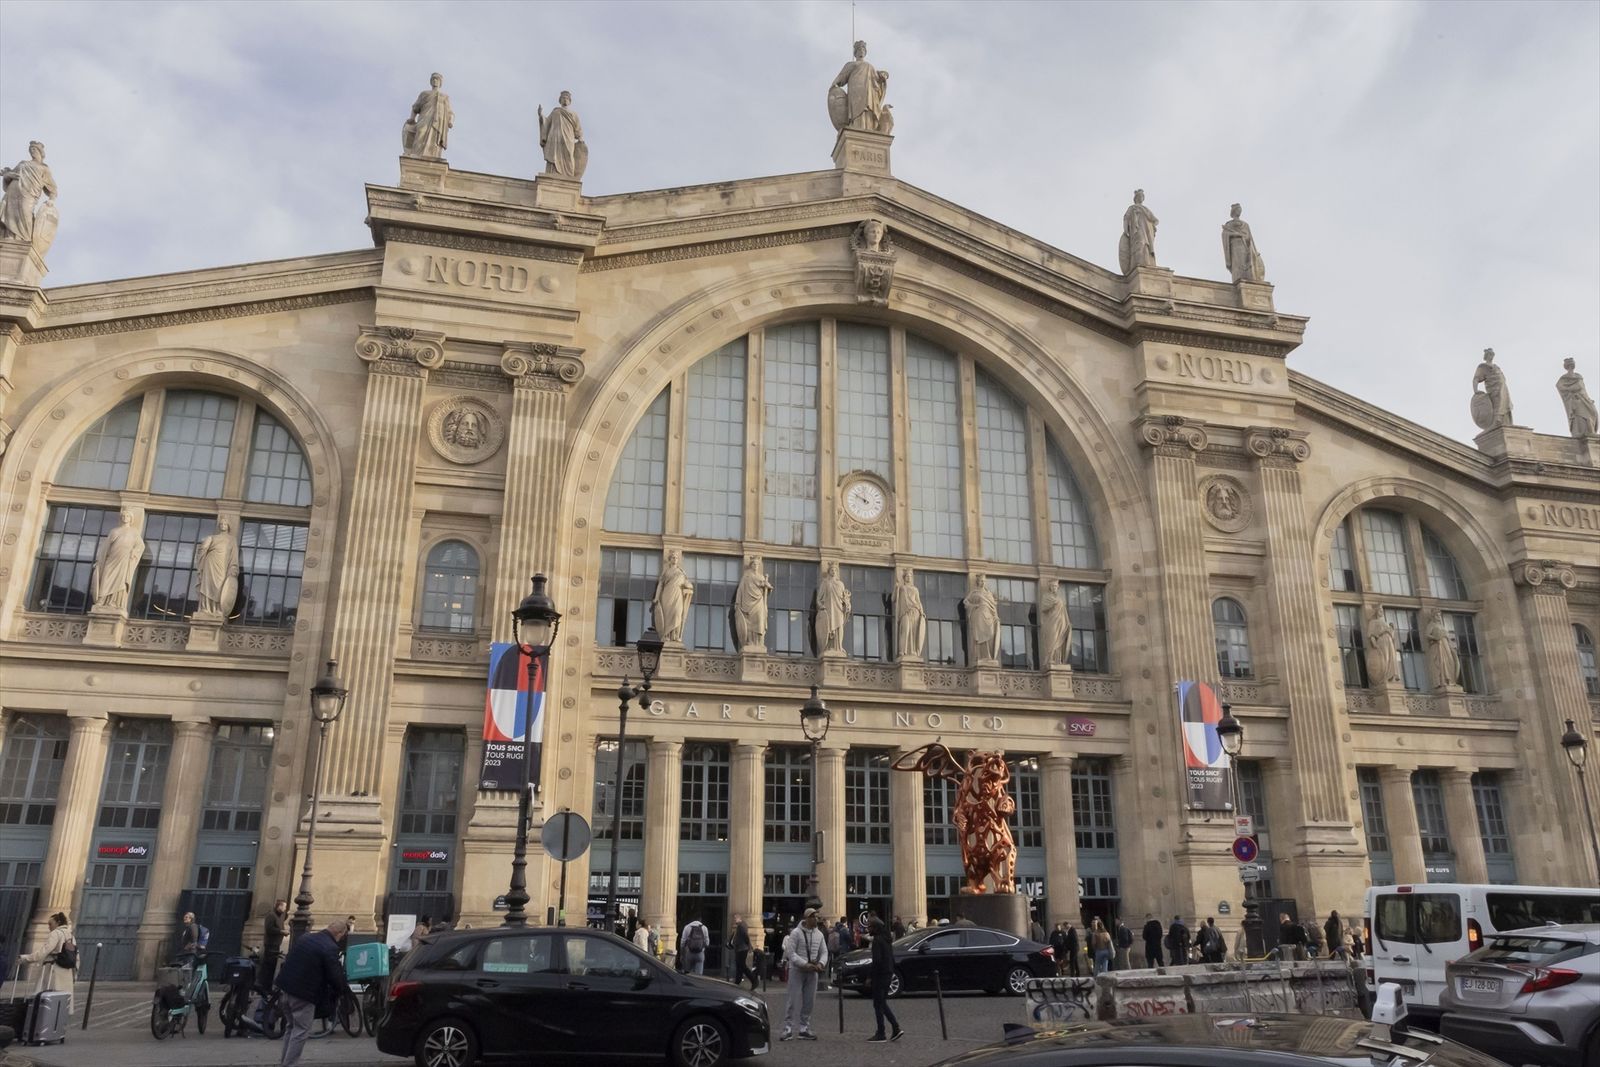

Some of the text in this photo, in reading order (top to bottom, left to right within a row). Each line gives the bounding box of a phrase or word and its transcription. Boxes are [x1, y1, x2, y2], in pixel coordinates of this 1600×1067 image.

[425, 255, 528, 293] NORD
[1176, 352, 1253, 385] NORD
[650, 700, 766, 721] GARE
[896, 712, 1004, 731] NORD
[1070, 723, 1096, 732] SNCF
